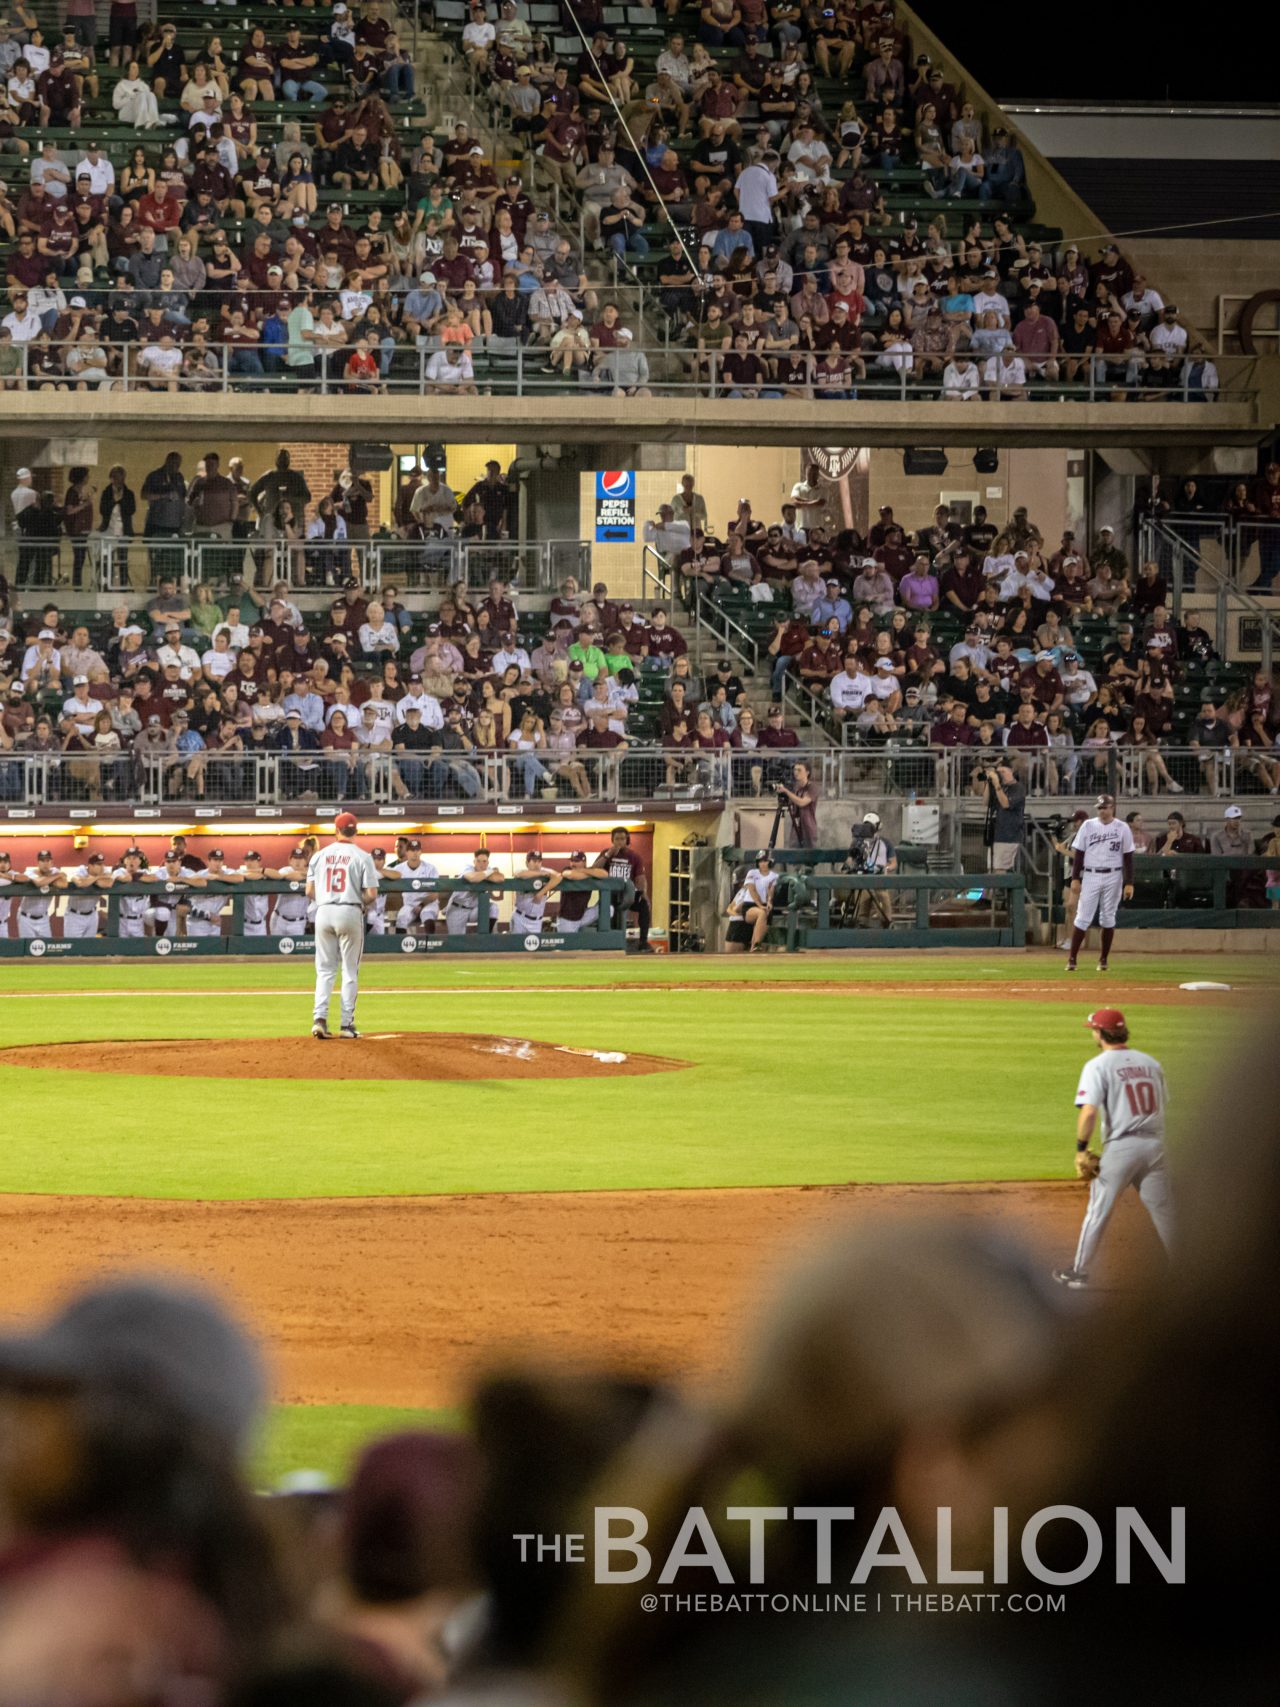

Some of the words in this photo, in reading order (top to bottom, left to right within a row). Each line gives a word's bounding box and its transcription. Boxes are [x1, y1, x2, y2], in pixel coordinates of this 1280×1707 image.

[602, 499, 629, 508] PEPSI
[600, 508, 630, 516] REFILL
[596, 516, 634, 525] STATION
[1109, 841, 1121, 852] 39
[326, 867, 346, 893] 13
[1124, 1082, 1157, 1117] 10
